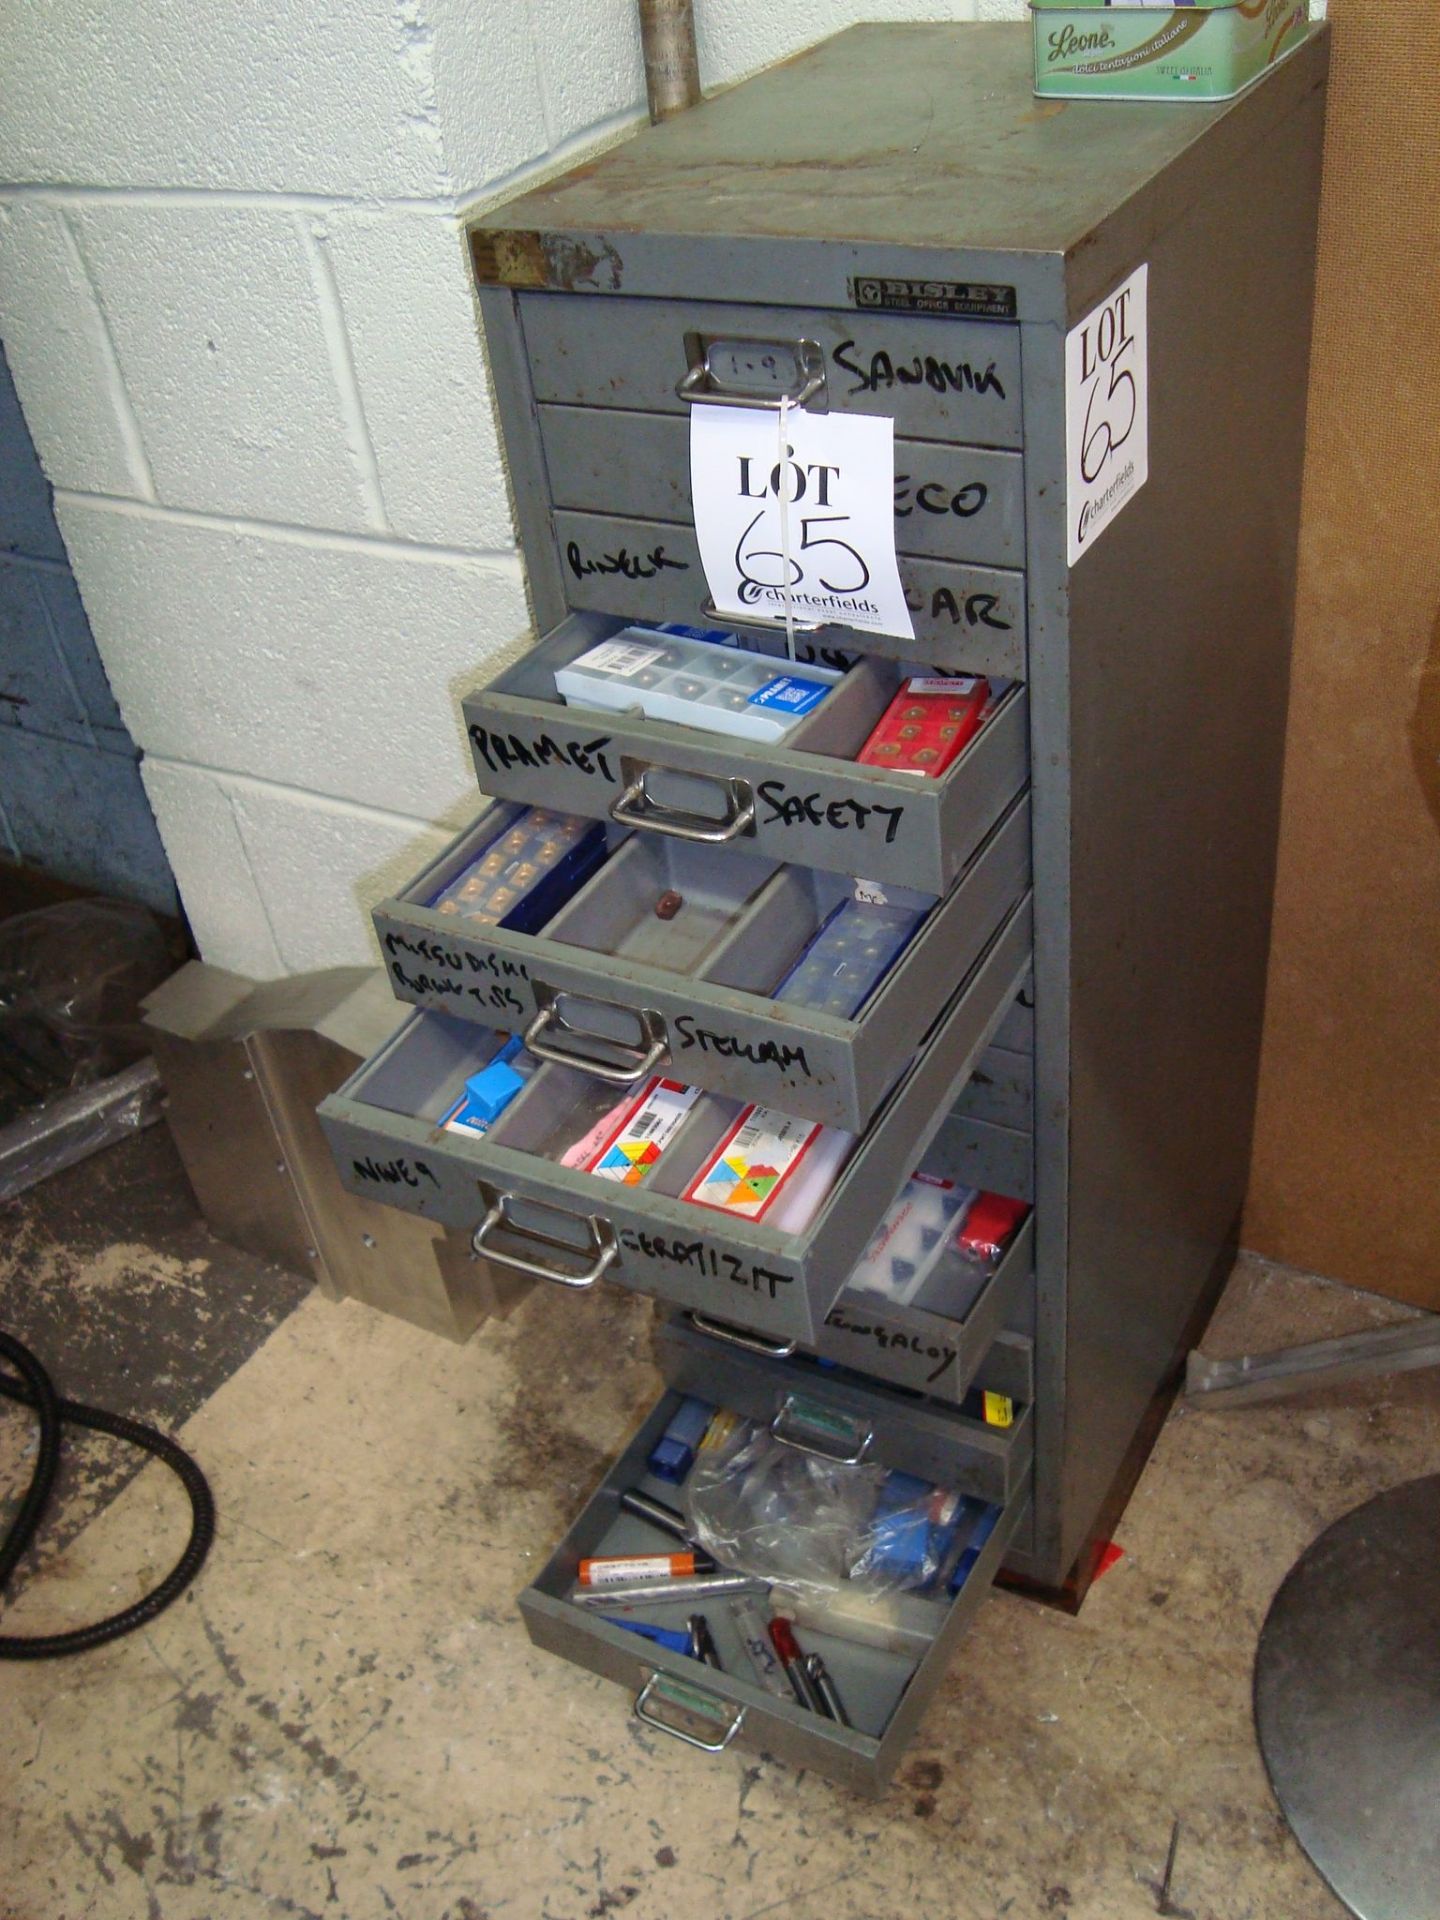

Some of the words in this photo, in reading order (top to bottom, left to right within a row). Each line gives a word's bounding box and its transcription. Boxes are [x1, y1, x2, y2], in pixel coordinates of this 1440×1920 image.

[1048, 24, 1115, 61] Leone
[1151, 19, 1188, 52] italiane
[885, 281, 1010, 301] BISLEY
[916, 299, 949, 310] OFFICE
[954, 302, 1010, 314] EQUIPMENT
[1080, 287, 1131, 385] LOT
[1080, 335, 1136, 483] 65
[736, 455, 841, 507] LOT
[1089, 460, 1135, 519] charterfields
[735, 510, 870, 593] 65
[469, 724, 617, 783] PRAMET
[757, 781, 905, 843] SAFETY
[619, 1228, 794, 1299] CERATIZIT
